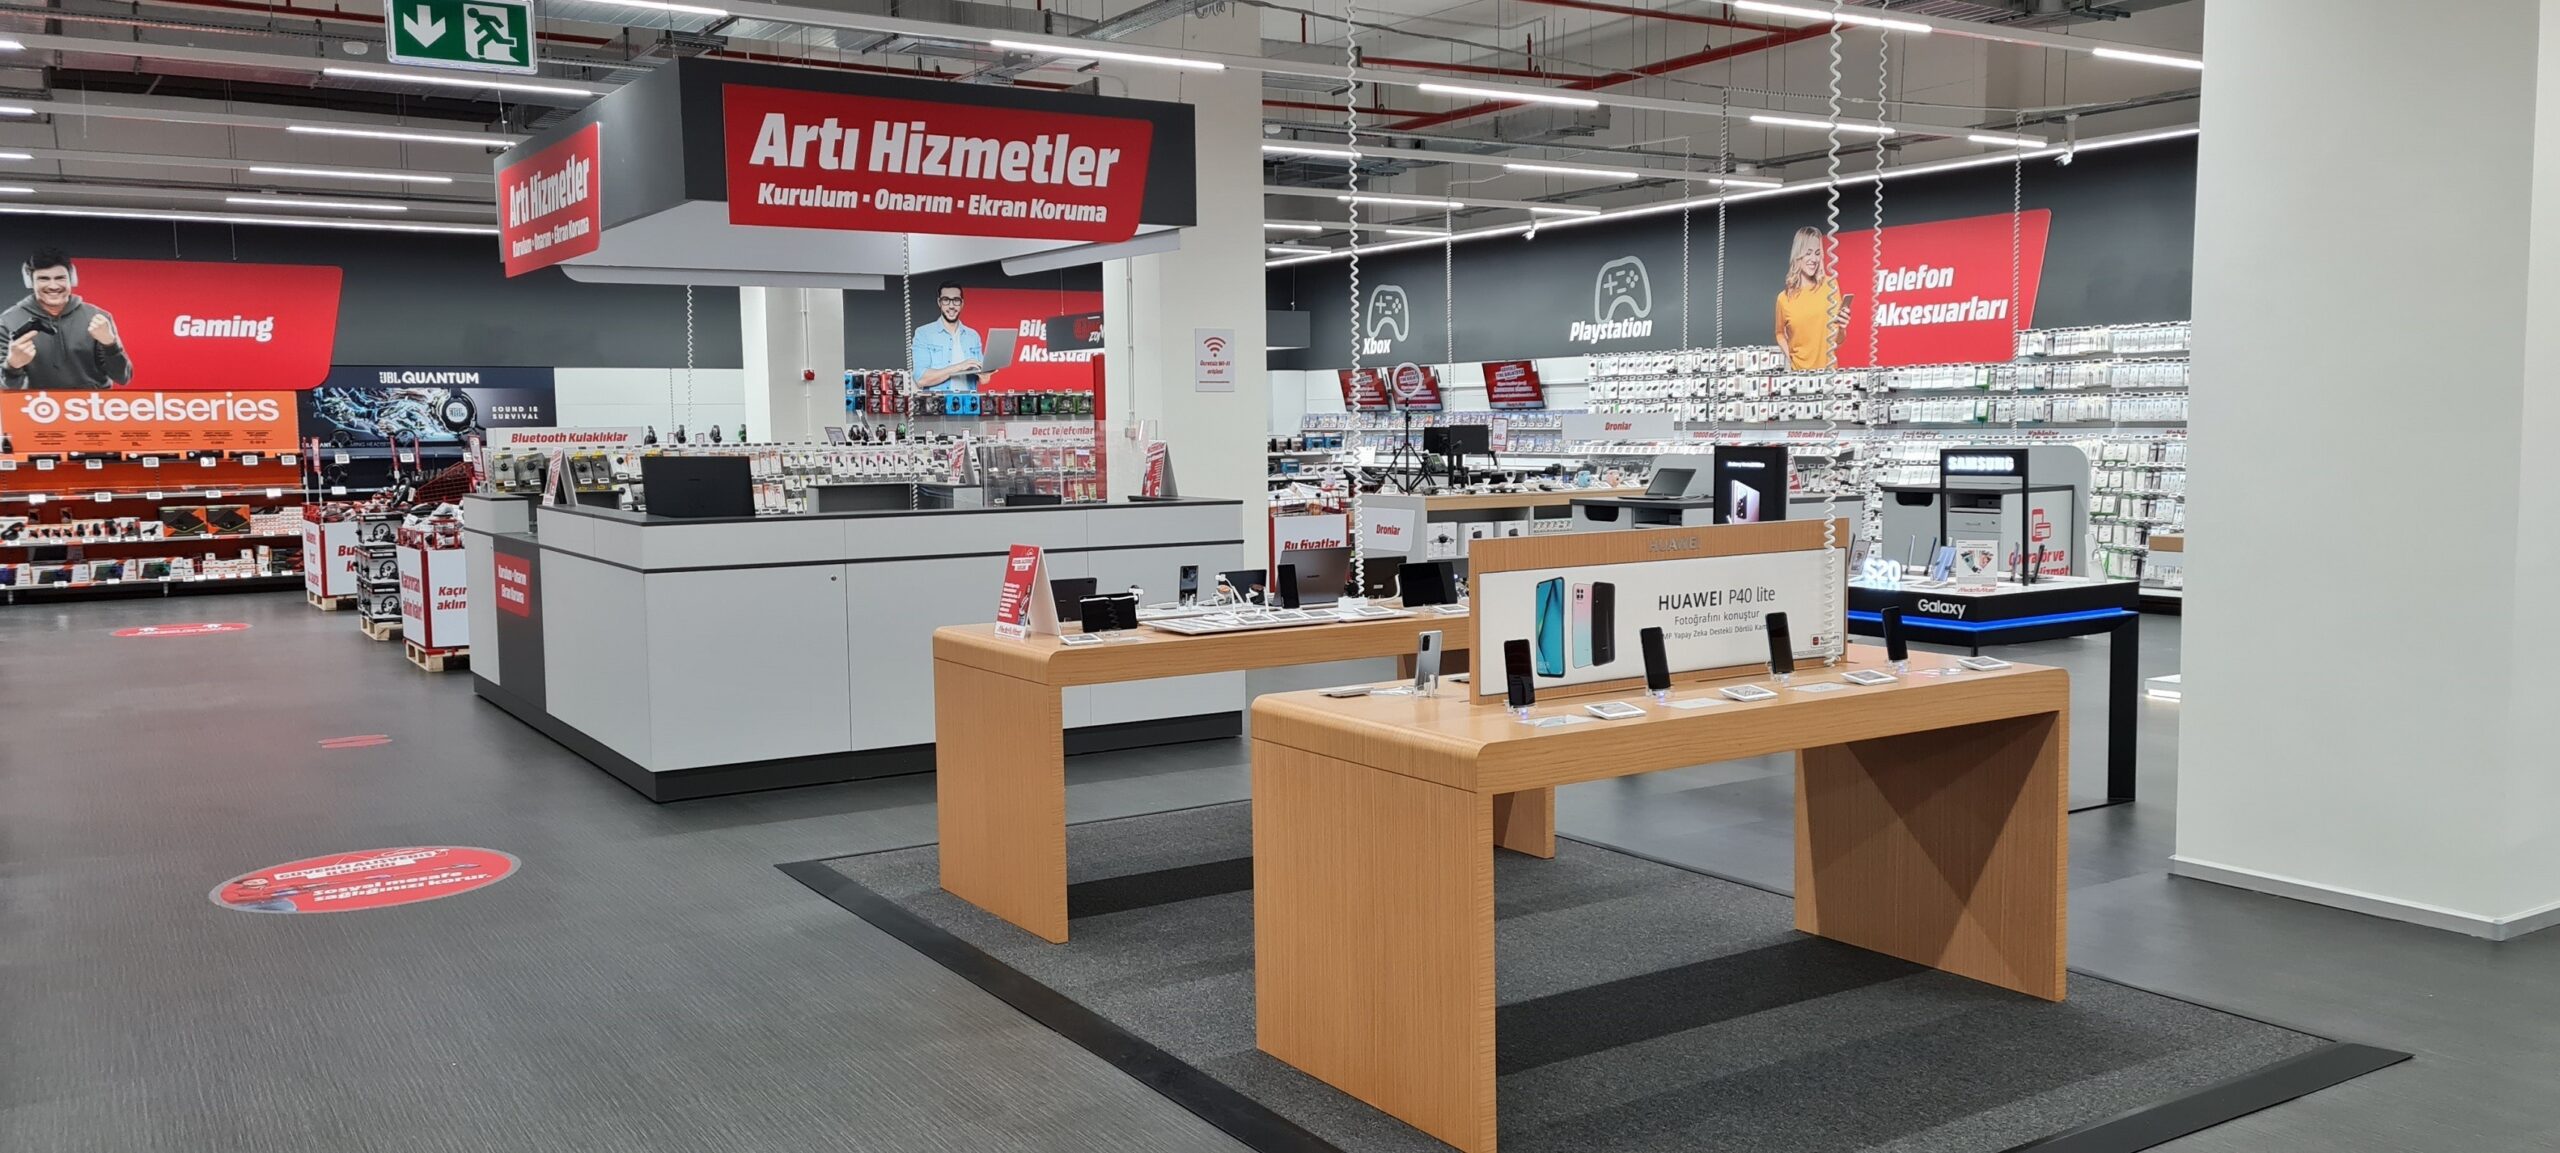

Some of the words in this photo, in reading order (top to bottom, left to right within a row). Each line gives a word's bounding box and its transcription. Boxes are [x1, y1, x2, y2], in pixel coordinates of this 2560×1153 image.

[749, 112, 860, 171] Artı
[868, 120, 1120, 188] Hizmetler
[509, 181, 529, 229] Artı
[530, 153, 590, 220] Hizmetler
[758, 182, 859, 210] Kurulum
[875, 188, 953, 215] Onarım
[968, 194, 1027, 219] Ekran
[1029, 199, 1107, 224] Koruma
[1877, 264, 1954, 293] Telefon
[1875, 295, 2009, 327] Aksesuarları
[173, 315, 275, 342] Gaming
[1569, 317, 1653, 344] Playstation
[1362, 337, 1391, 355] Xbox
[379, 372, 400, 384] JBL
[401, 371, 479, 384] QUANTUM
[64, 391, 280, 422] steelseries
[1032, 426, 1050, 435] Dect
[1605, 422, 1632, 431] Dronlar
[1787, 431, 1801, 439] 5000
[511, 433, 566, 443] Bluetooth
[568, 432, 628, 443] Kulaklıklar
[1947, 456, 2014, 471] SAMSUNG
[1376, 524, 1401, 535] Dronlar
[338, 545, 355, 556] Bu
[1284, 541, 1297, 550] Bu
[1300, 538, 1341, 550] fiyatlar
[2053, 550, 2064, 562] ve
[1864, 559, 1901, 582] S20
[438, 586, 467, 597] Kaçır
[1658, 590, 1722, 611] HUAWEI
[1729, 587, 1752, 605] P40
[1757, 586, 1776, 602] lite
[437, 600, 466, 610] aklın
[1918, 599, 1966, 619] Galaxy
[1674, 613, 1721, 627] Fotoğrafını
[1723, 609, 1760, 622] konuştur
[1674, 631, 1692, 640] Yapay
[1693, 629, 1708, 637] Zeka
[1709, 626, 1732, 635] Destekli
[1735, 624, 1753, 633] Dörtlü
[313, 881, 381, 896] Sosyal
[385, 872, 462, 886] mesafe
[428, 874, 492, 886] korur.
